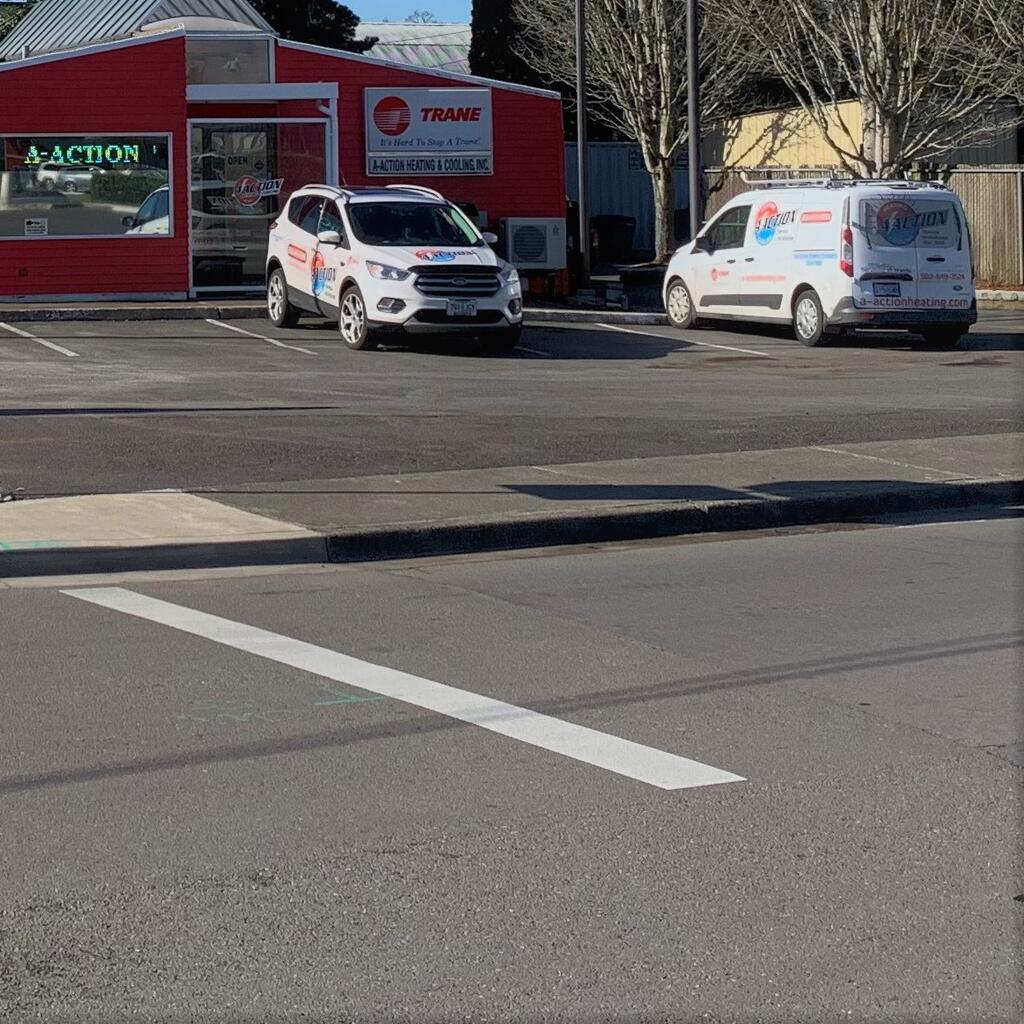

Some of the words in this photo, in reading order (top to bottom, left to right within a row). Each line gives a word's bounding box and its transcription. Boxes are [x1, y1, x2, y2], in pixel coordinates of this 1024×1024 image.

[421, 107, 481, 122] TRANE
[24, 145, 139, 164] A-ACTION
[228, 156, 248, 166] OPEN
[373, 159, 404, 171] A-ACTION
[406, 159, 436, 171] HEATING
[437, 159, 442, 171] &
[860, 297, 968, 310] a-actionheating.com
